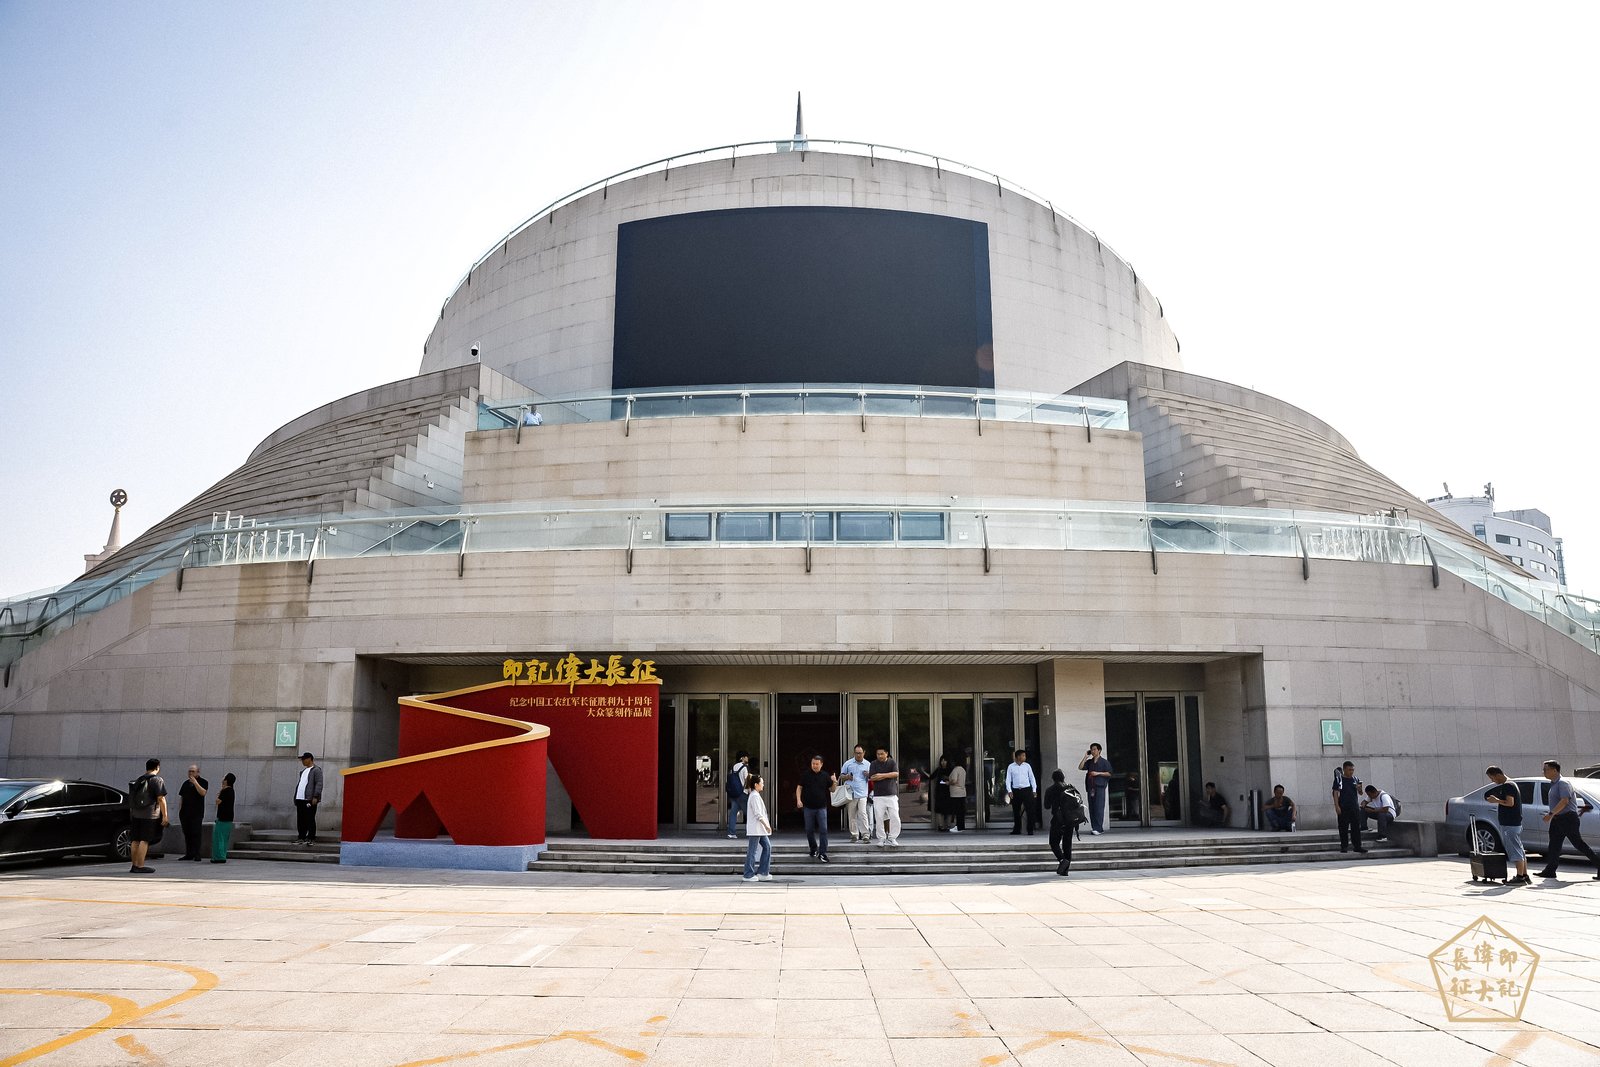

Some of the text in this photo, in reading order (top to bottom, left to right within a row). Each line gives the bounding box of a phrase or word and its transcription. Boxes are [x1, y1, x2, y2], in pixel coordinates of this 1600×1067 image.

[509, 696, 653, 707] 纪念中国工农红军长征胜利九十周年
[586, 707, 652, 718] 大众篆刻作品展
